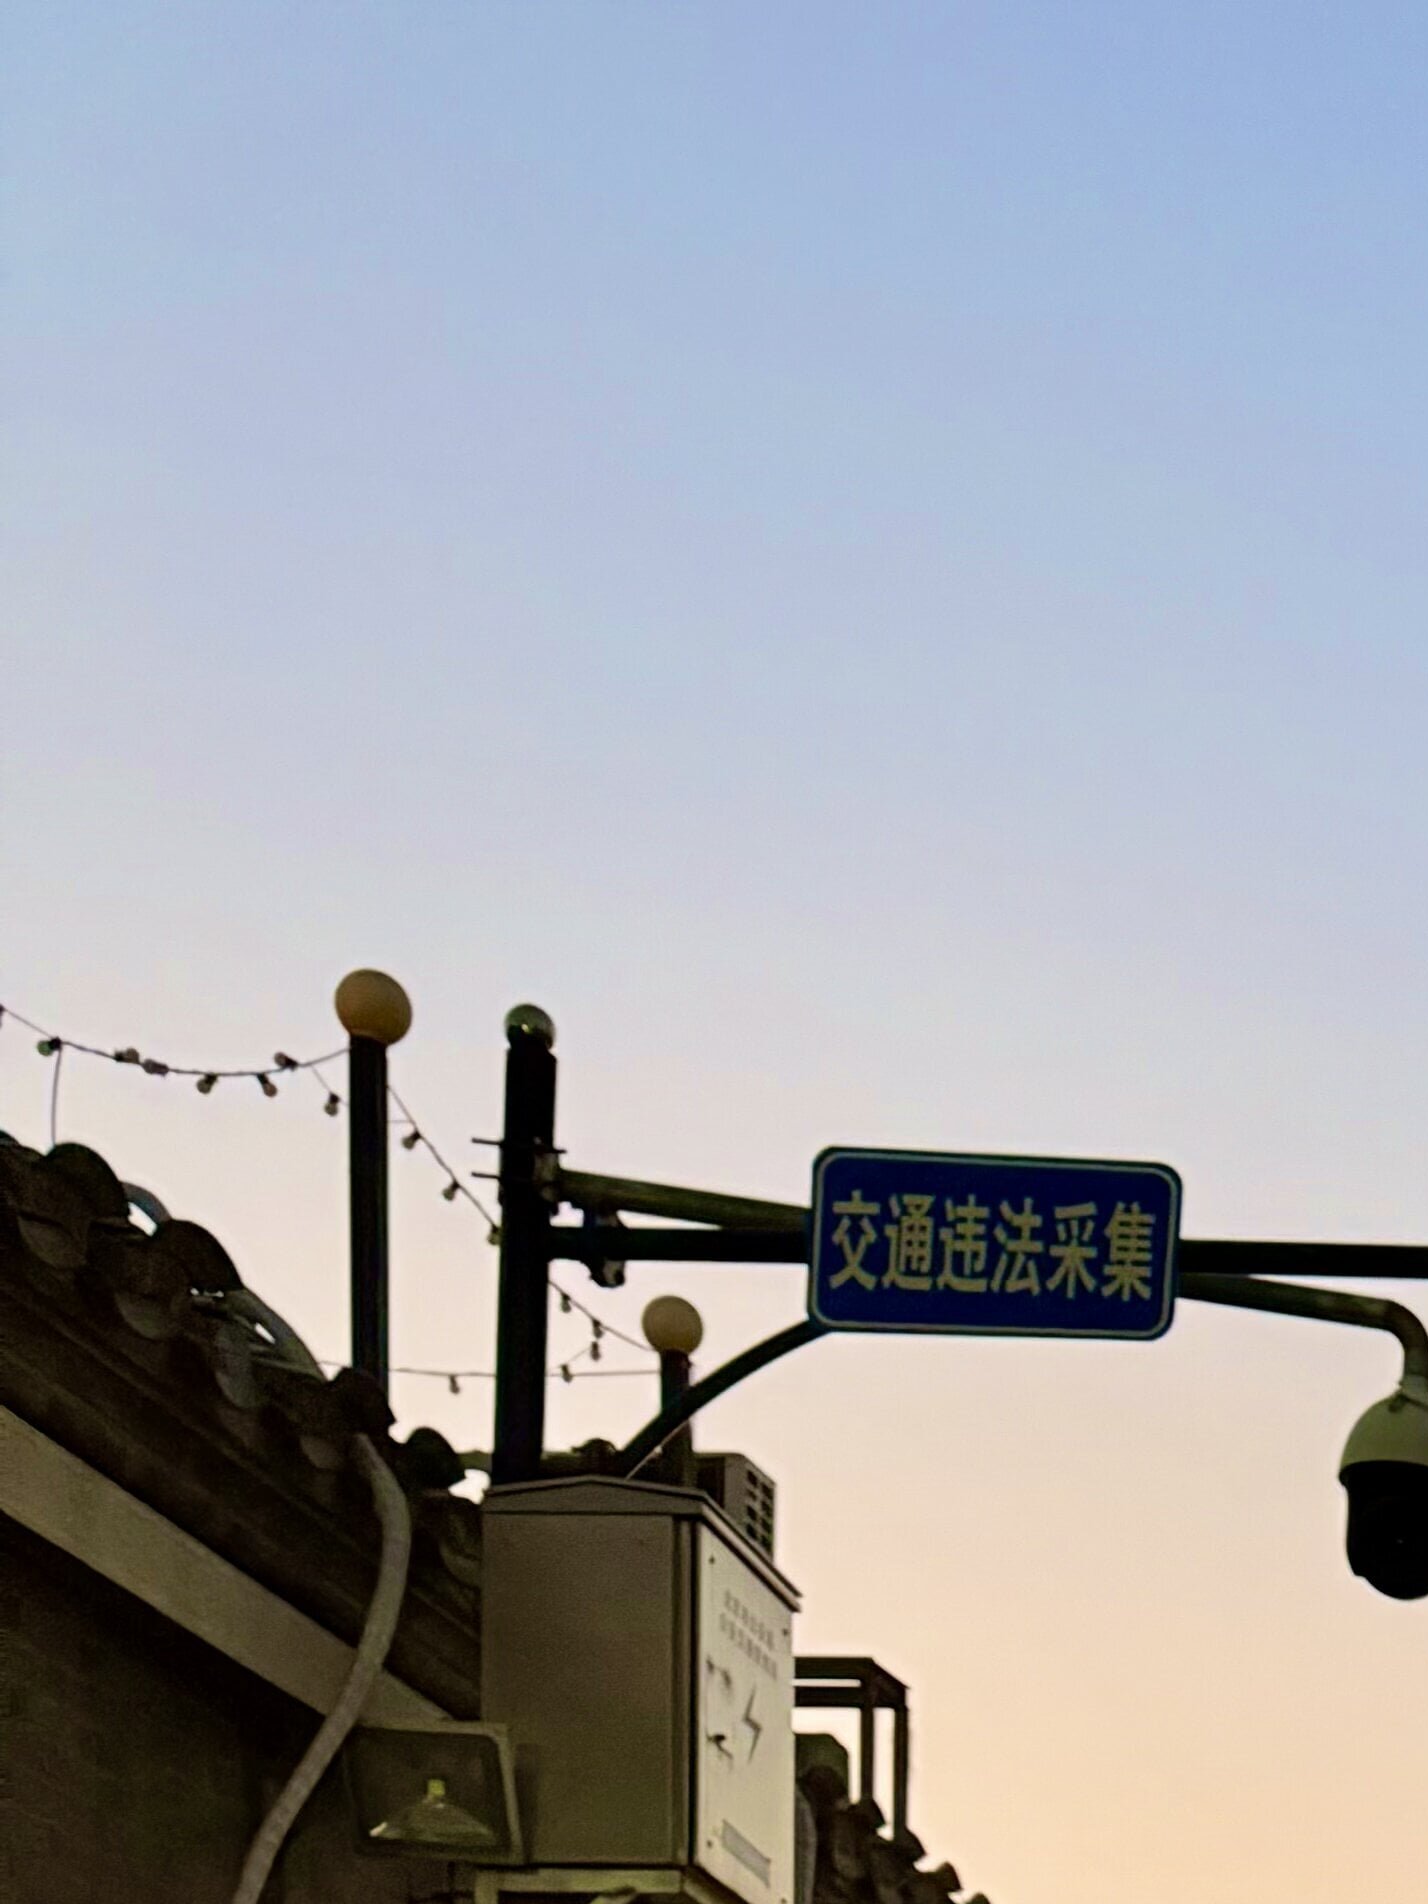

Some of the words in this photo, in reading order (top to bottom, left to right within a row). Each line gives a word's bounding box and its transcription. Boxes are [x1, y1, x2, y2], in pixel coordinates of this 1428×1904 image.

[828, 1189, 1157, 1303] 交通违法采集
